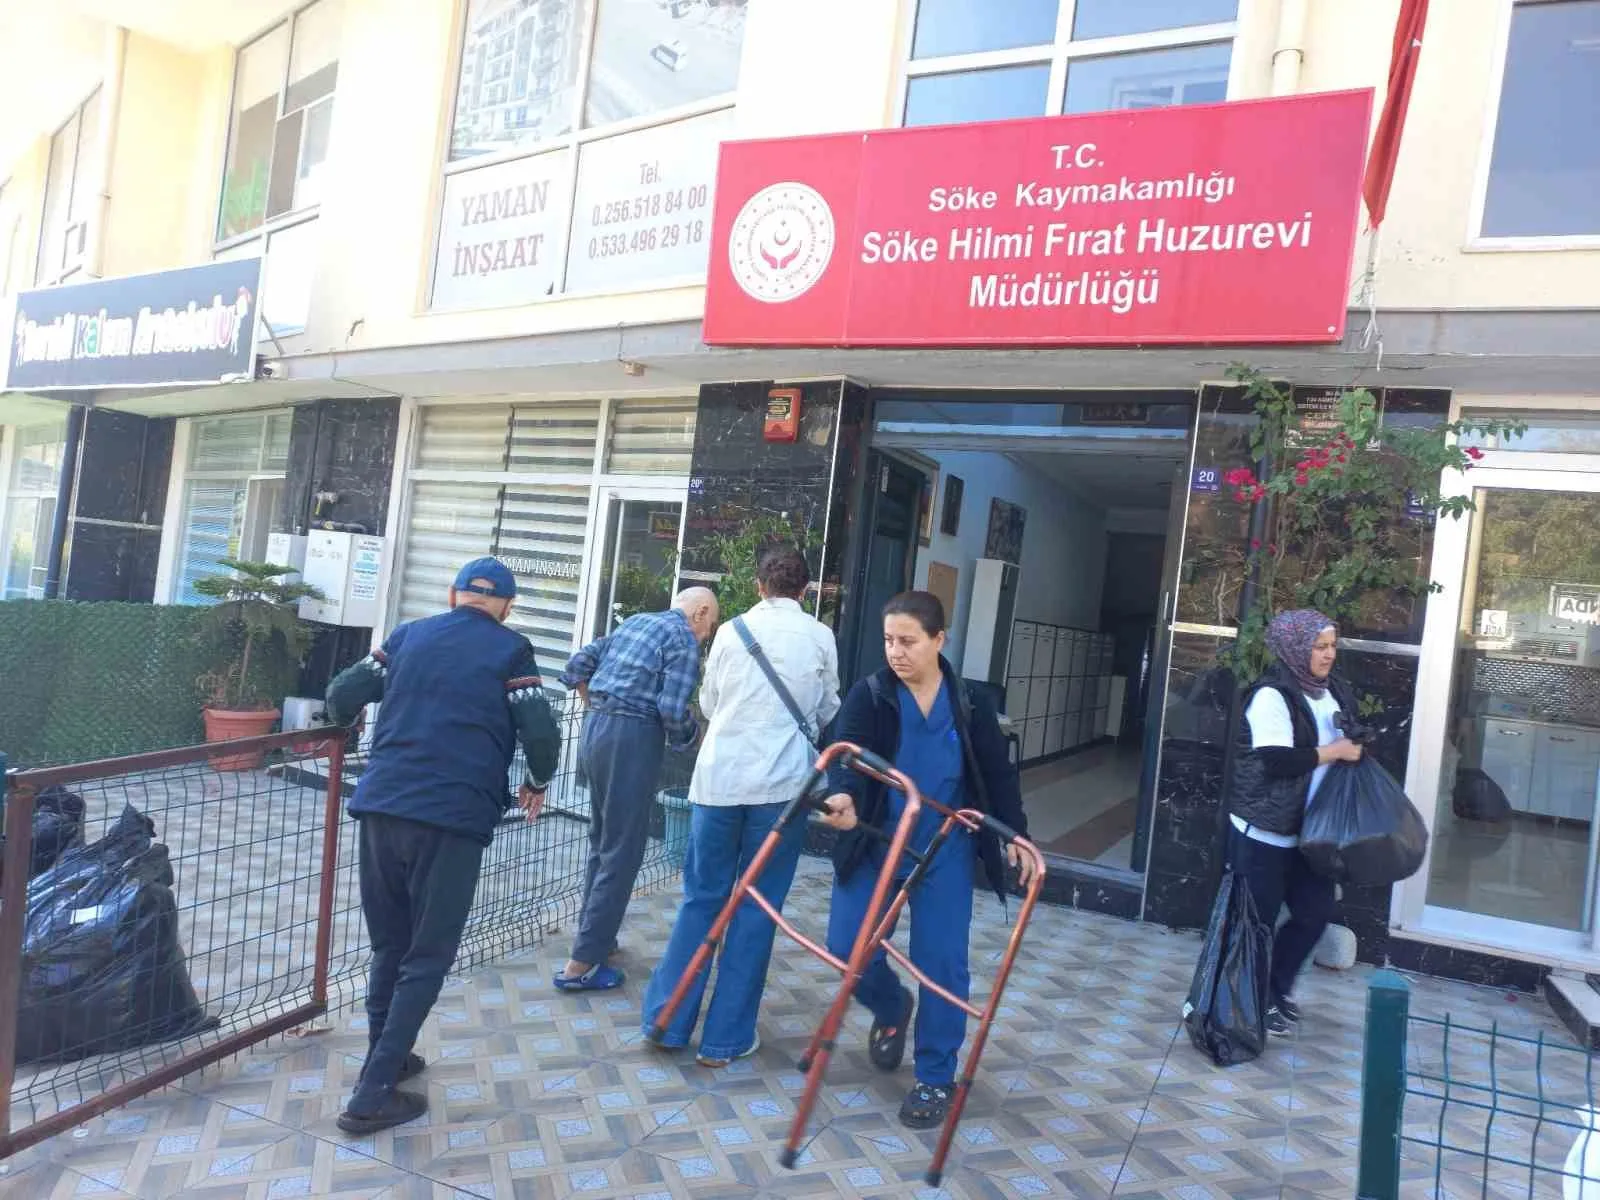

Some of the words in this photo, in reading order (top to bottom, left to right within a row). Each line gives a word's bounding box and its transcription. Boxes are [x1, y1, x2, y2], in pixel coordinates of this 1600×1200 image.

[639, 160, 662, 185] Tel.
[1050, 143, 1104, 170] T.C.
[460, 179, 550, 227] YAMAN
[592, 194, 661, 227] 0.256.518
[664, 190, 683, 217] 84
[688, 184, 708, 210] 00
[928, 186, 998, 212] Söke
[1015, 170, 1236, 212] Kaymakamlığı
[452, 234, 544, 277] İNŞAAT
[588, 228, 657, 260] 0.533.496
[661, 224, 680, 249] 29
[685, 220, 704, 245] 18
[861, 230, 939, 264] Söke
[948, 224, 1034, 261] Hilmi
[1044, 222, 1127, 257] Fırat
[1137, 211, 1312, 253] Huzurevi
[969, 269, 1160, 314] Müdürlüğü
[1199, 470, 1215, 482] 20
